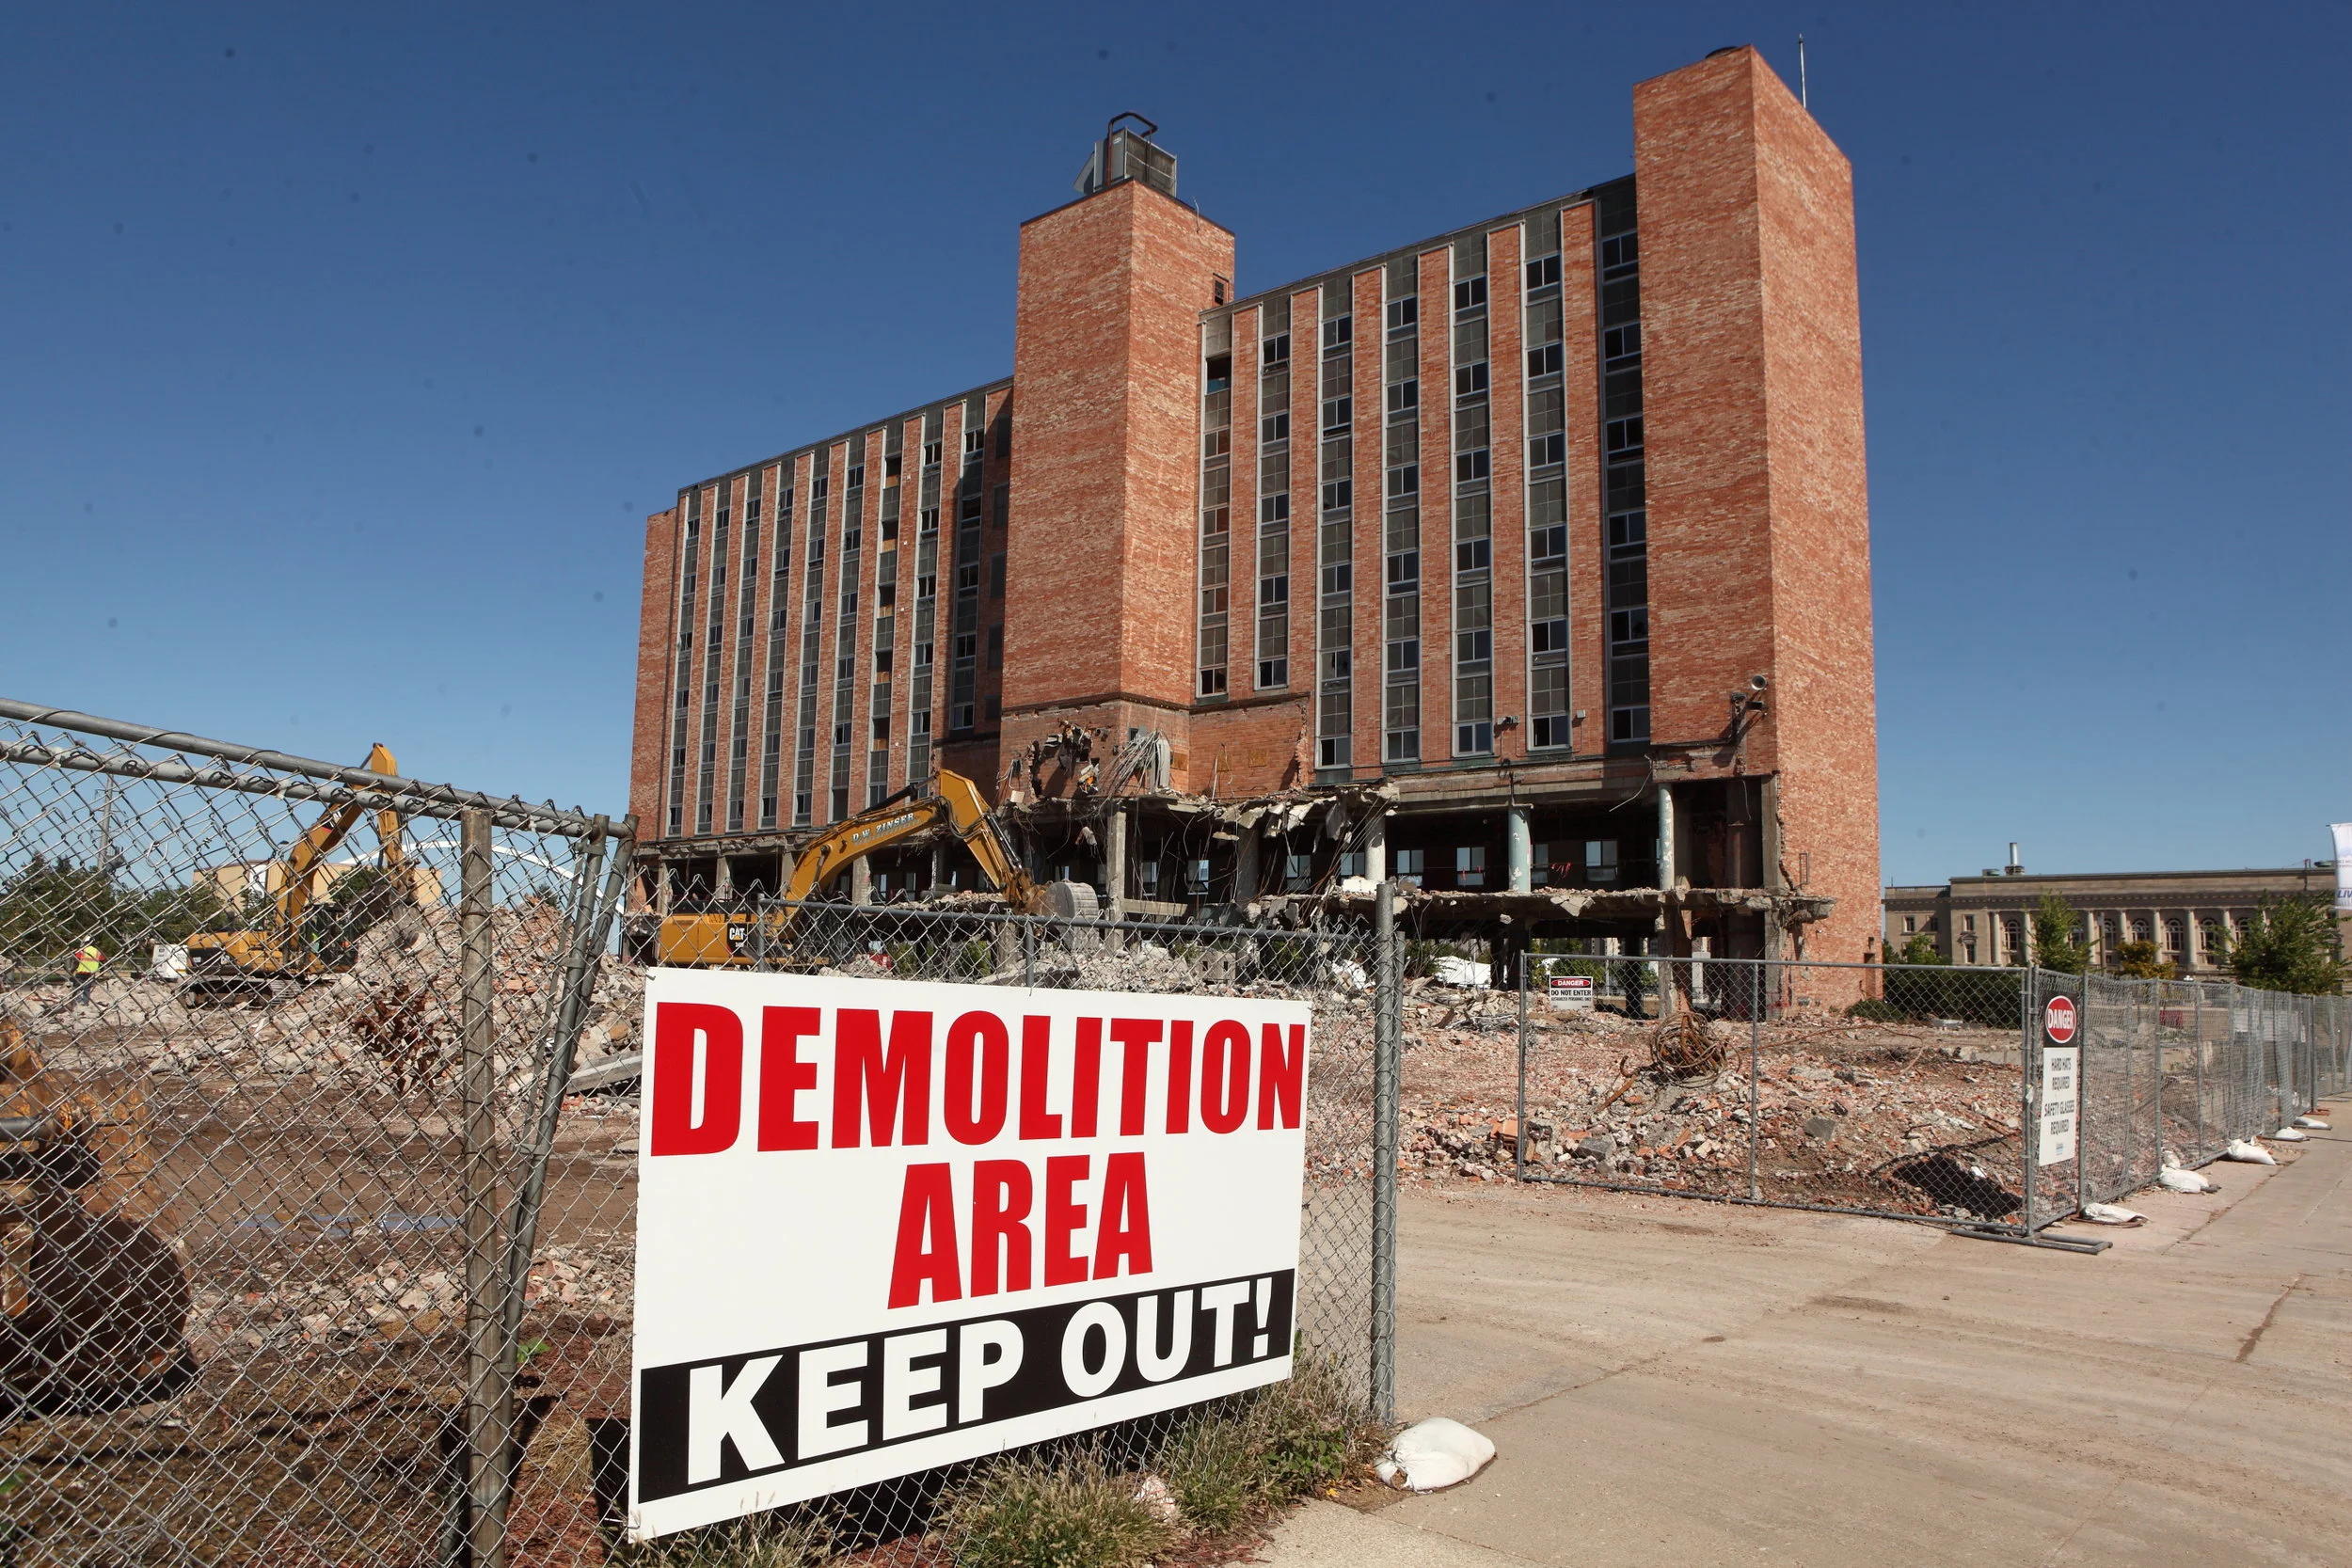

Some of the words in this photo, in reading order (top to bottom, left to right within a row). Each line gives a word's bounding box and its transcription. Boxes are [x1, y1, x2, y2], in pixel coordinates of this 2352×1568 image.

[876, 813, 914, 833] ZINSER
[729, 927, 745, 941] CAT
[2047, 1008, 2074, 1030] DANGER
[2051, 1057, 2062, 1071] HARD
[2062, 1057, 2072, 1070] HATS
[651, 1002, 1306, 1157] DEMOLITION
[2052, 1075, 2070, 1091] REQUIRED
[2044, 1101, 2059, 1117] SAFETY
[2059, 1100, 2075, 1115] GLASSES
[2051, 1119, 2069, 1135] REQUIRED
[888, 1152, 1153, 1309] AREA
[688, 1320, 1025, 1484] KEEP
[1061, 1277, 1273, 1398] OUT!
